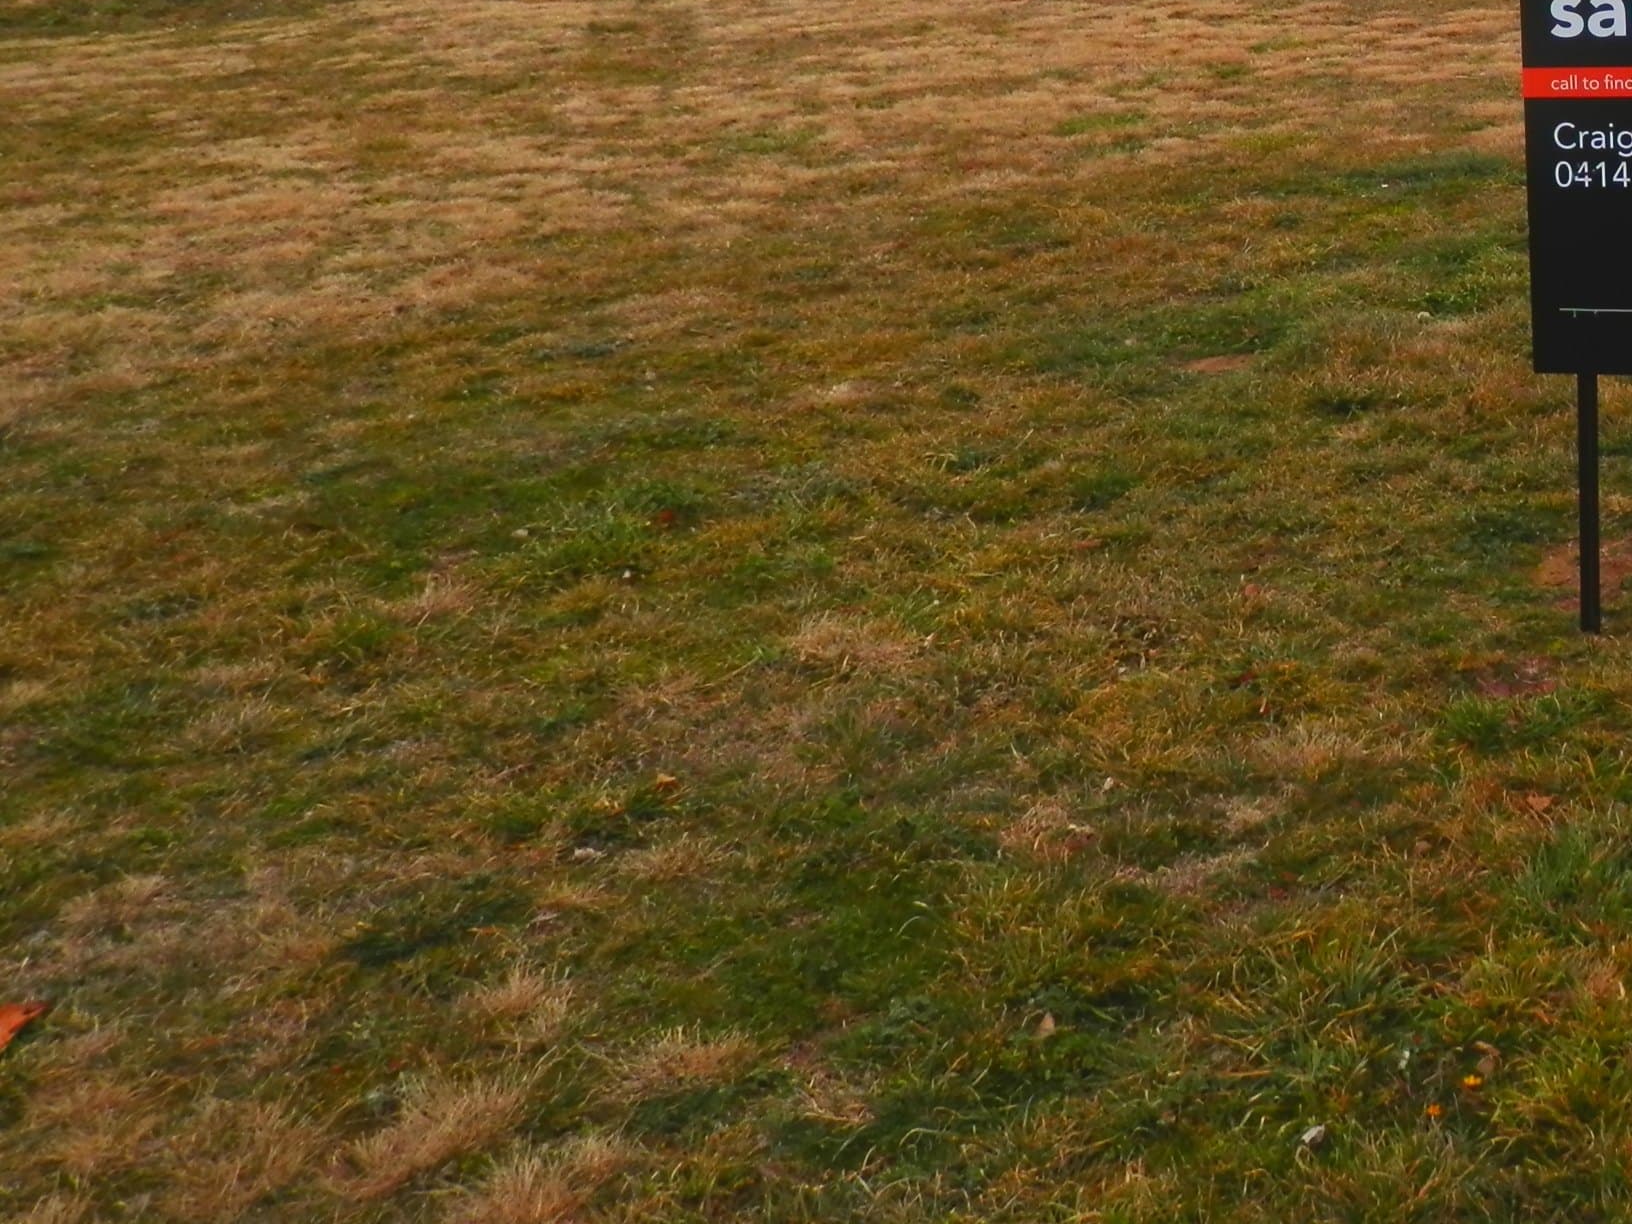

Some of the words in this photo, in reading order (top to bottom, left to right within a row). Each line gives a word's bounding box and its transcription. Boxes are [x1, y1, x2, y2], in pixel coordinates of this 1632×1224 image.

[1550, 75, 1578, 90] call
[1582, 77, 1600, 90] to
[1554, 161, 1631, 188] 0414
